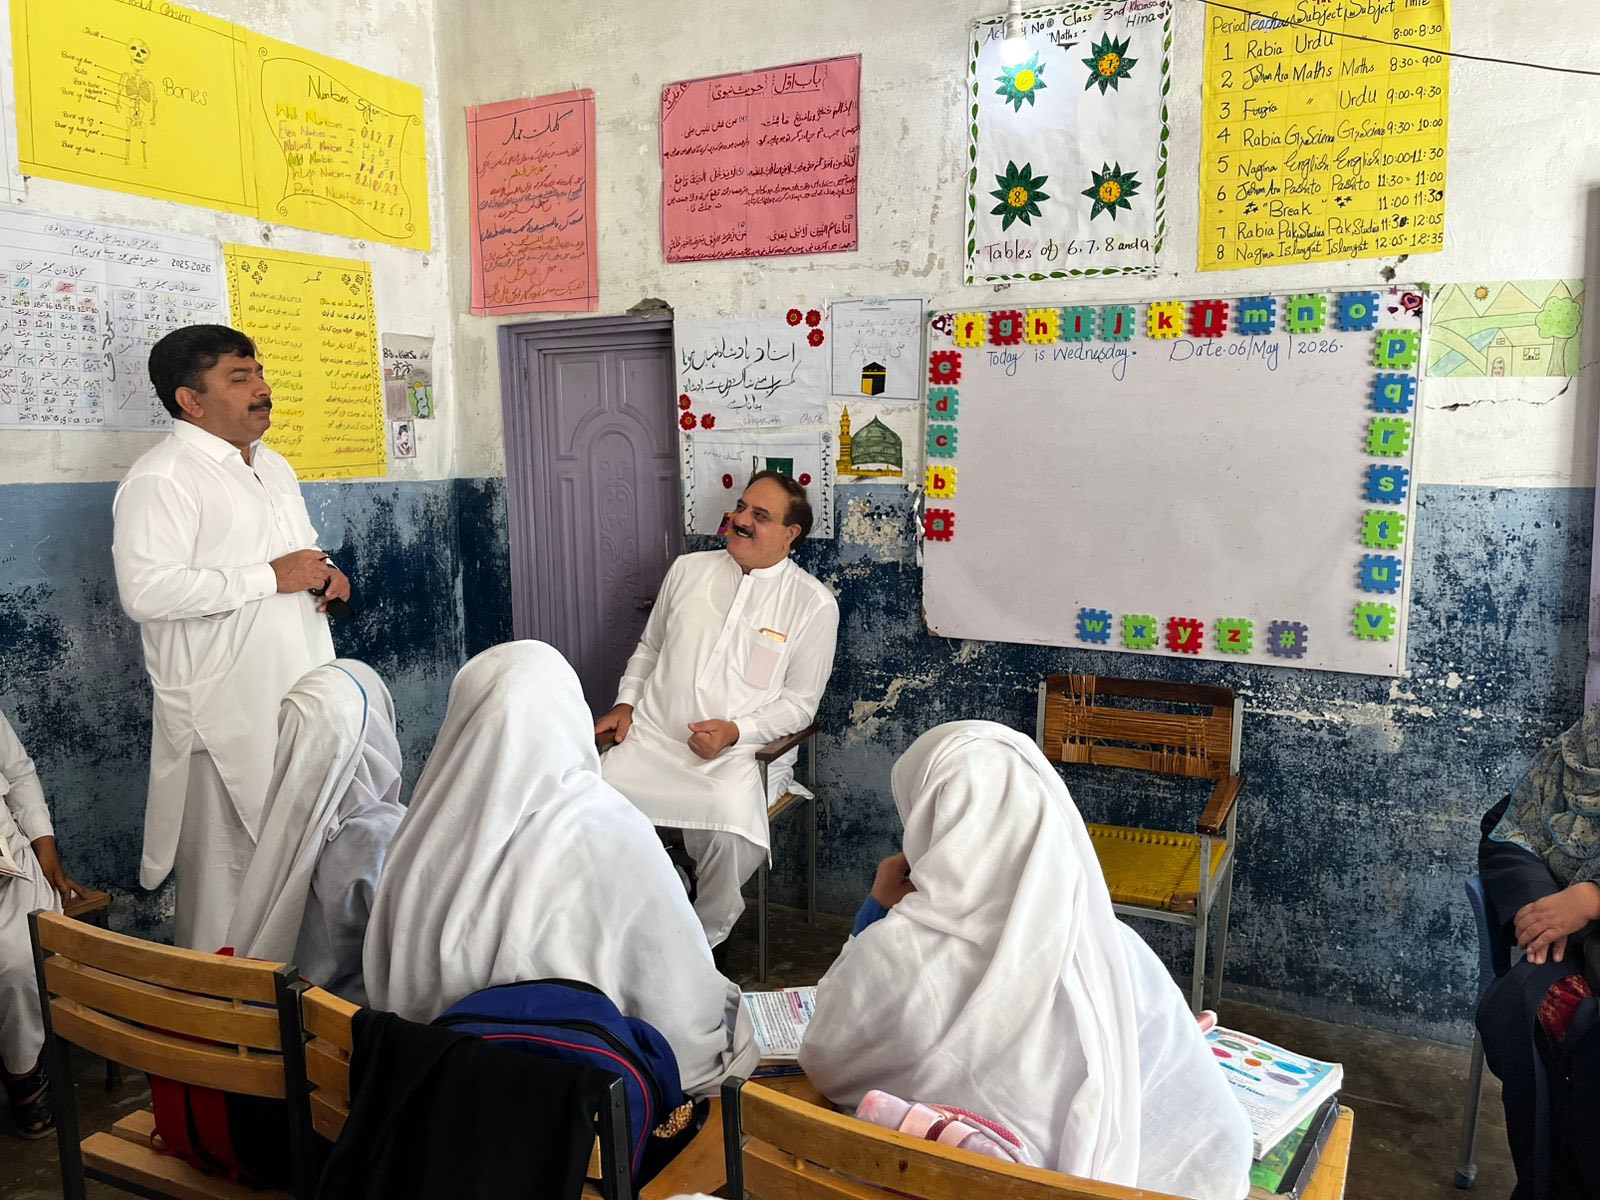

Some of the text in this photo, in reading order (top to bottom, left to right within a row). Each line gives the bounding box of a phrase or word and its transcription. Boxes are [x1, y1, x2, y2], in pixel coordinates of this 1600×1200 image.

[1063, 12, 1092, 27] Class
[1126, 13, 1156, 28] Hina
[1212, 12, 1247, 36] Period
[1222, 42, 1234, 61] 1
[1246, 40, 1283, 59] Rabia
[1295, 30, 1334, 53] Urdu
[1221, 70, 1233, 88] 2
[1292, 60, 1332, 82] Maths
[1341, 57, 1374, 77] Maths
[163, 77, 208, 106] Bones
[1219, 102, 1230, 119] 3
[1340, 85, 1377, 109] Urdu
[1216, 127, 1231, 143] 4
[1243, 128, 1281, 147] Rabia
[1217, 155, 1229, 173] 5
[1284, 150, 1329, 179] English
[1333, 146, 1380, 176] English
[1014, 191, 1021, 203] 8
[1105, 187, 1112, 196] 9
[1216, 185, 1226, 201] 6
[1284, 178, 1322, 196] Pashto
[1332, 173, 1370, 191] Pashto
[1216, 226, 1226, 239] 7
[1237, 221, 1275, 240] Rabia
[1040, 238, 1058, 261] of
[1105, 237, 1114, 251] 8
[1118, 238, 1141, 250] and
[1216, 244, 1225, 260] 8
[171, 258, 212, 273] 2025-2026
[988, 348, 1024, 377] Today
[1035, 348, 1045, 360] is
